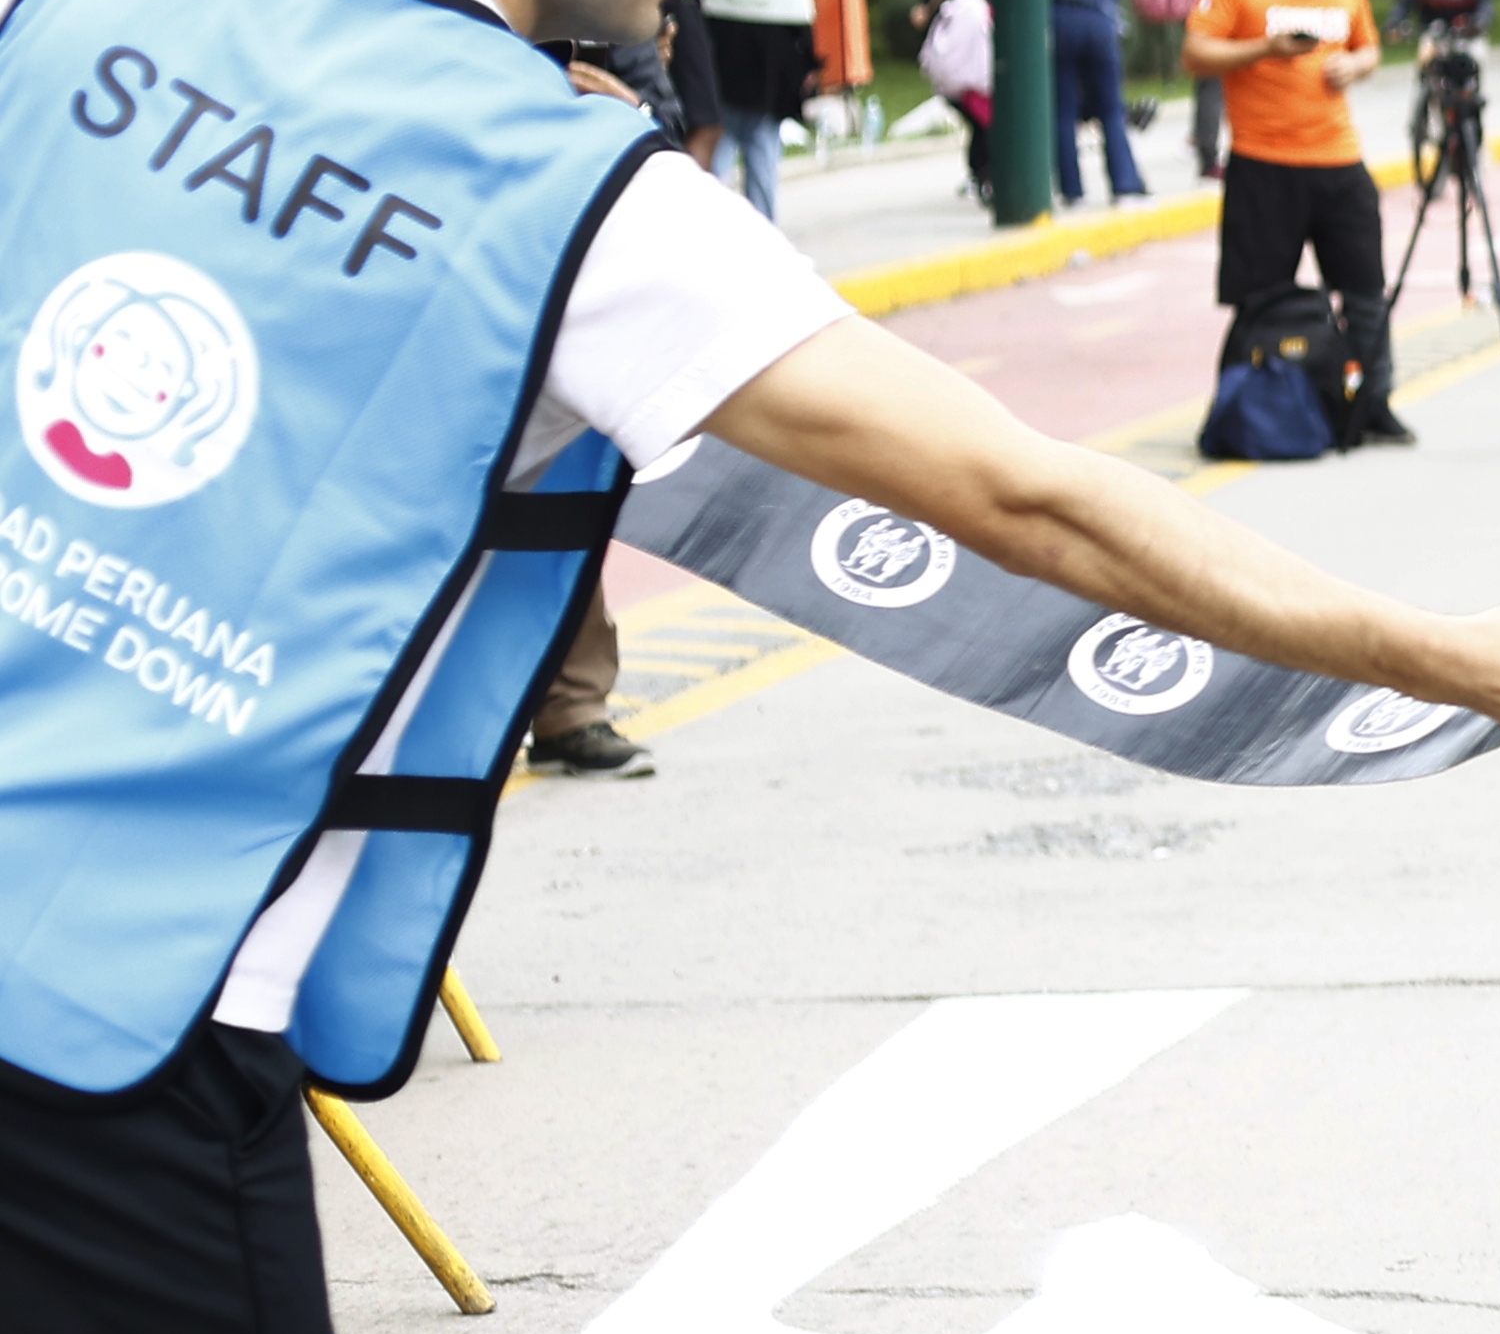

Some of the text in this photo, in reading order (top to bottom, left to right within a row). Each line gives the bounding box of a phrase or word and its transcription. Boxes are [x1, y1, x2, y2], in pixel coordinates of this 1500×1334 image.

[71, 45, 444, 277] STAFF
[54, 539, 275, 687] PERUANA
[831, 577, 874, 602] 1984
[104, 624, 258, 736] DOWN
[1088, 684, 1132, 709] 1984
